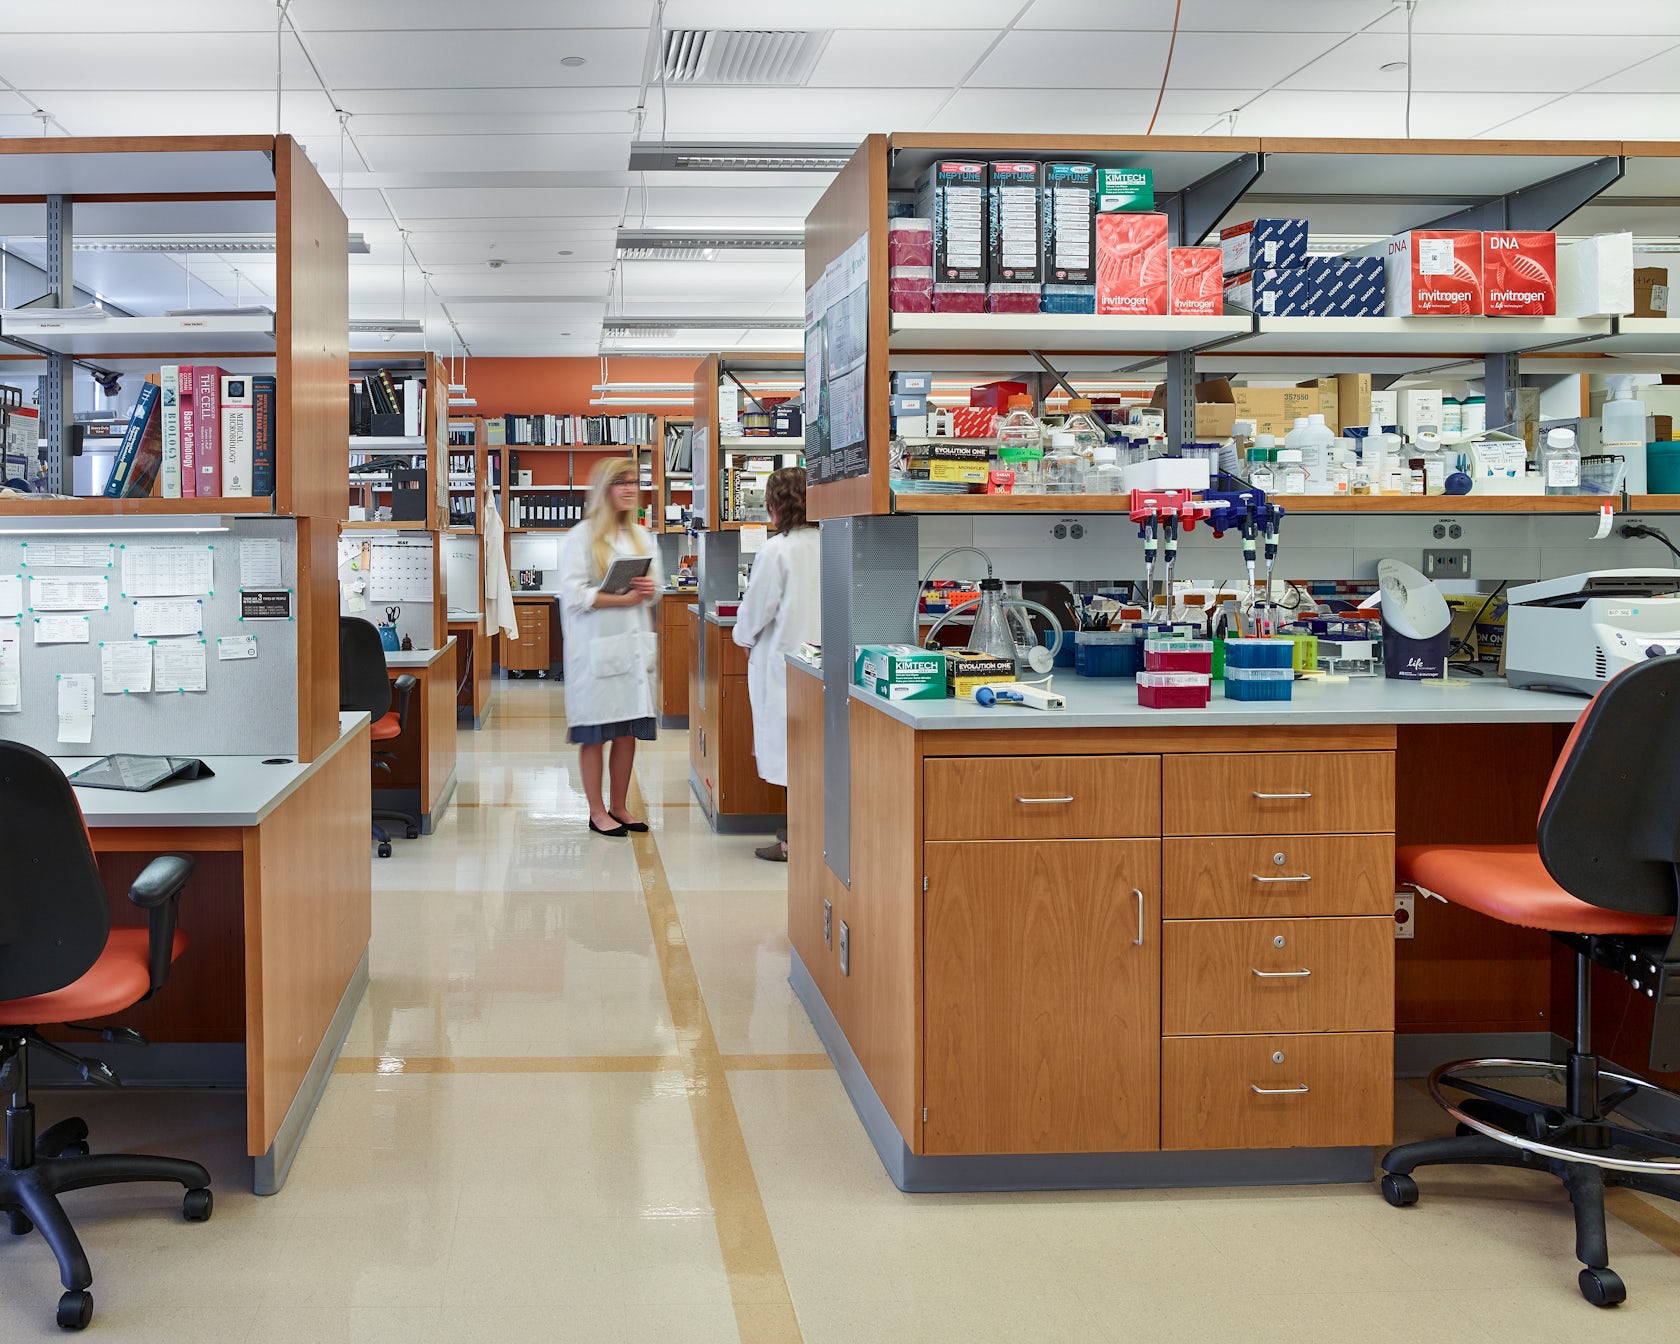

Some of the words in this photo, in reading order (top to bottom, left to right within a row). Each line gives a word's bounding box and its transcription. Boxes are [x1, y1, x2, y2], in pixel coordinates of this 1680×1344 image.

[939, 172, 980, 180] NEPTUNE
[994, 172, 1034, 180] NEPTUNE
[1048, 174, 1088, 182] NEPTUNE
[1106, 174, 1146, 182] KIMTECH
[1258, 226, 1274, 242] QIAGEN
[1278, 219, 1292, 235] QIAGEN
[1289, 232, 1304, 248] QIAGEN
[1490, 237, 1520, 250] DNA
[1388, 240, 1406, 256] DNA
[1280, 253, 1296, 268] QIAGEN
[1315, 268, 1331, 284] QIAGEN
[1336, 261, 1351, 276] QIAGEN
[1368, 266, 1383, 281] QIAGEN
[1276, 270, 1292, 284] QIAGEN
[1348, 274, 1364, 289] QIAGEN
[1288, 282, 1304, 298] QIAGEN
[1309, 289, 1324, 304] QIAGEN
[1328, 281, 1343, 297] QIAGEN
[1361, 286, 1376, 302] QIAGEN
[1101, 296, 1148, 307] invitrogen
[1174, 298, 1214, 309] invitrogen
[1340, 294, 1356, 310] QIAGEN
[1418, 290, 1472, 304] invitrogen
[1490, 290, 1545, 304] invitrogen
[1320, 302, 1336, 317] QIAGEN
[1423, 302, 1431, 310] life
[1495, 302, 1504, 310] life
[201, 374, 210, 394] THE
[202, 395, 210, 420] CELL
[184, 410, 193, 430] Basic
[168, 413, 176, 460] BIOLOGY
[184, 432, 194, 468] Pathology
[1406, 658, 1423, 670] life
